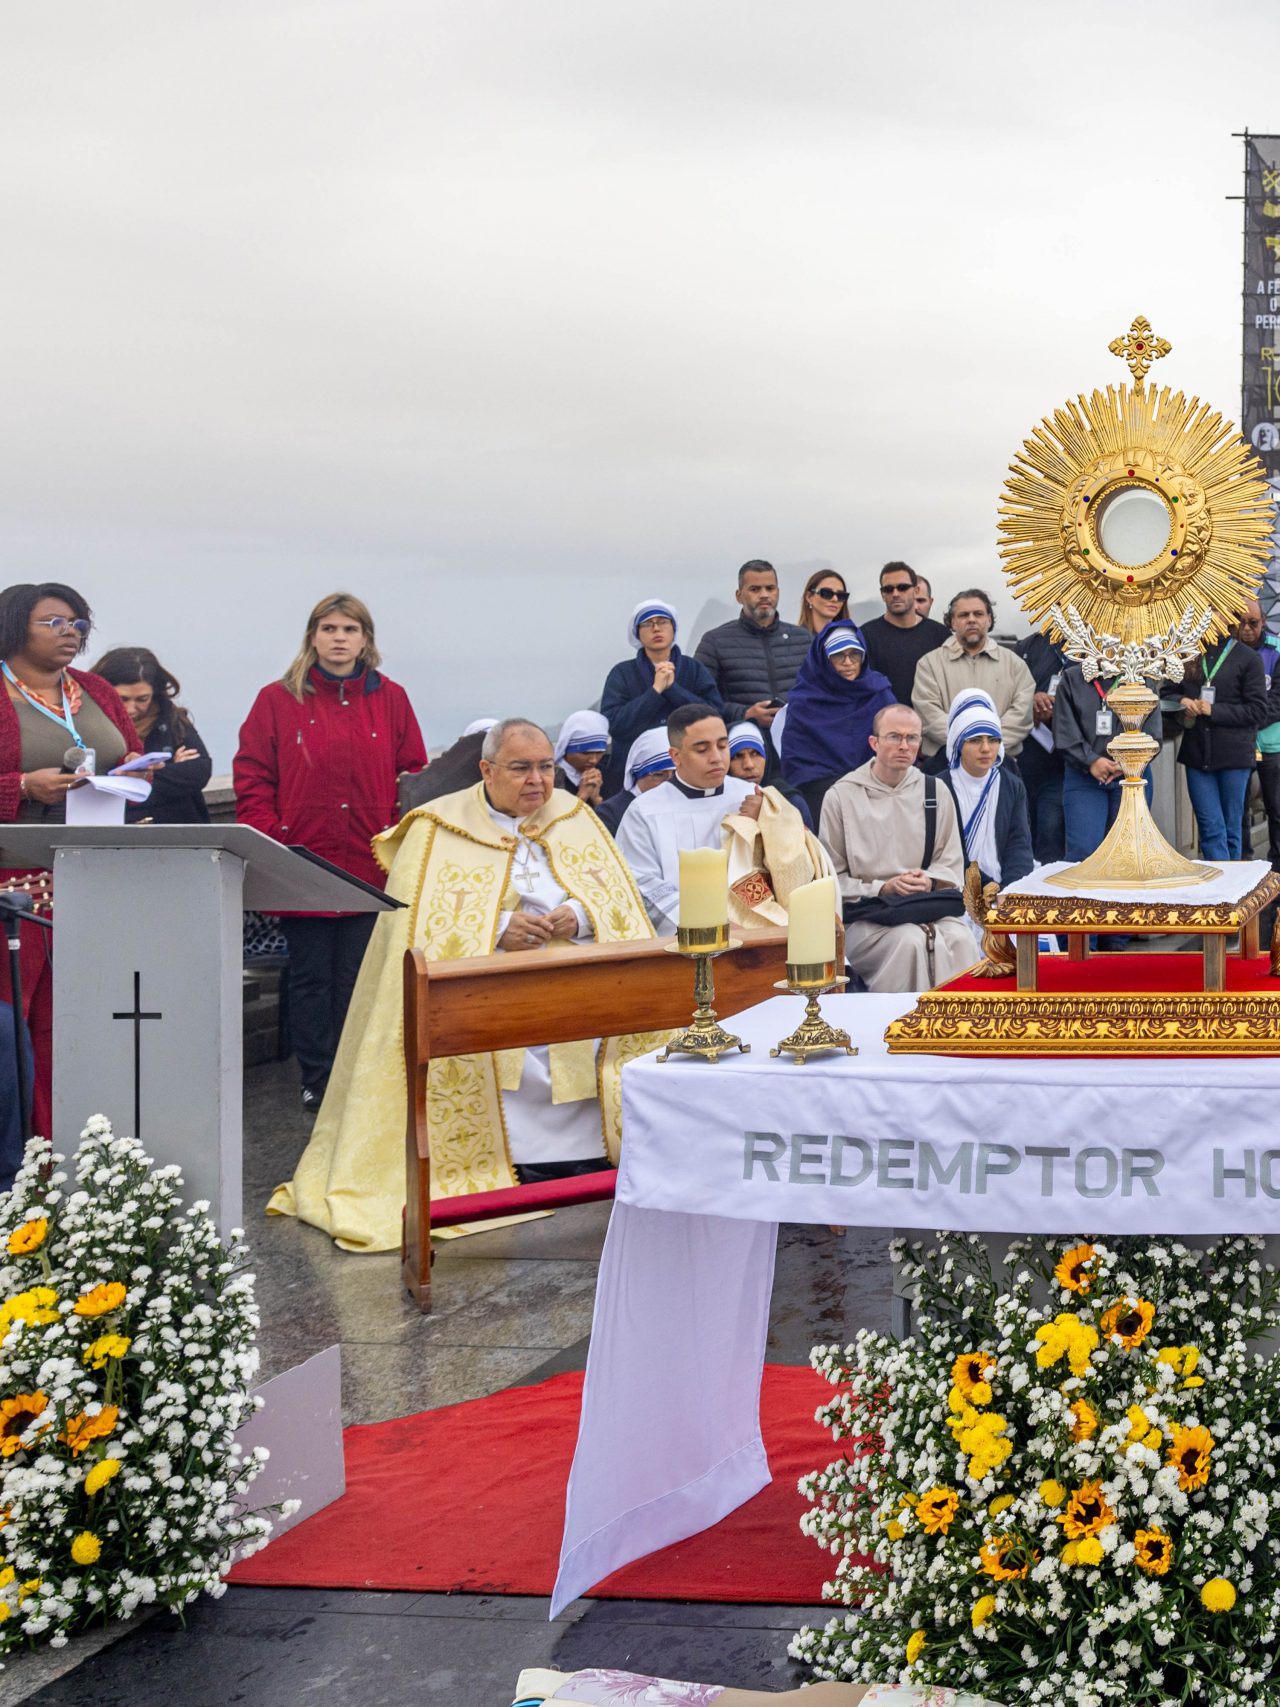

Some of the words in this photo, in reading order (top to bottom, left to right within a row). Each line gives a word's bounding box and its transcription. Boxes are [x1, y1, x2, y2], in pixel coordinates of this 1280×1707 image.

[1257, 280, 1265, 295] A
[1268, 278, 1280, 295] FÉ
[1270, 298, 1277, 312] O
[742, 1131, 1165, 1198] REDEMPTOR
